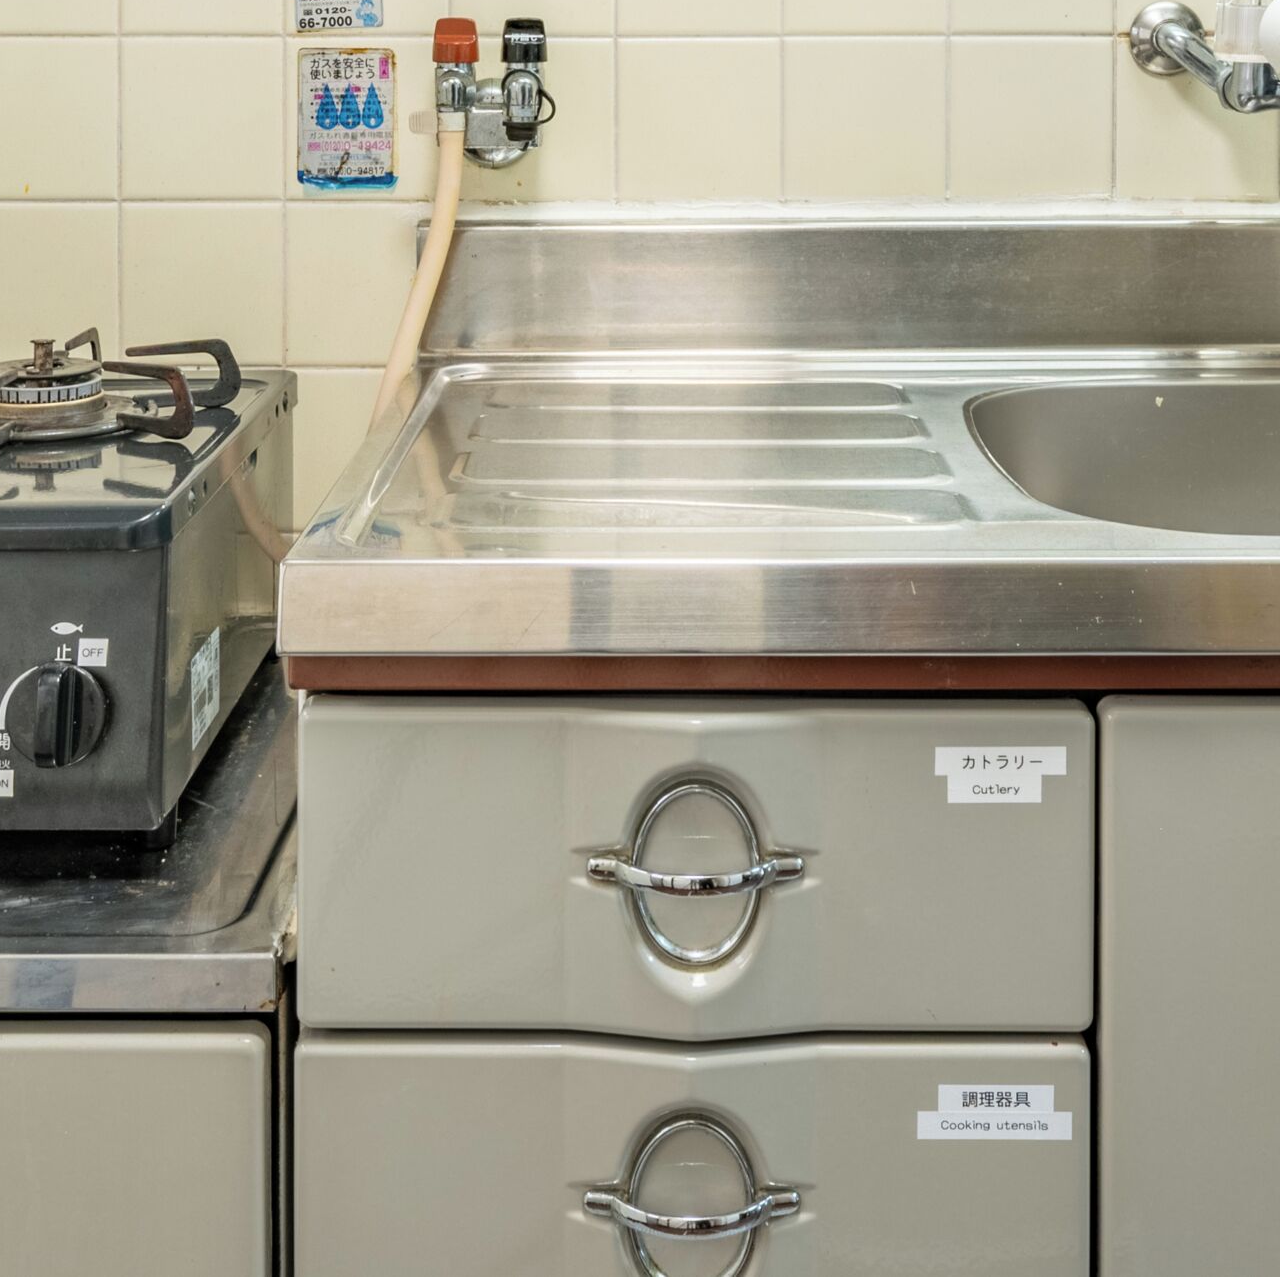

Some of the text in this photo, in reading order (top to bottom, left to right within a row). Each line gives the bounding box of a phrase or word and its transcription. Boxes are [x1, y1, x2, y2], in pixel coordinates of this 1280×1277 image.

[315, 7, 352, 15] 0120-
[299, 16, 352, 29] 66-7000
[310, 58, 375, 70] ガスを安全に
[310, 69, 375, 80] 使いましょう
[54, 643, 72, 661] 止
[81, 648, 104, 658] OFF
[962, 754, 1043, 770] カトラリー
[972, 784, 1020, 796] Cutlery
[961, 1091, 1032, 1108] 調理器具
[940, 1120, 1049, 1131] Cooking utensils
